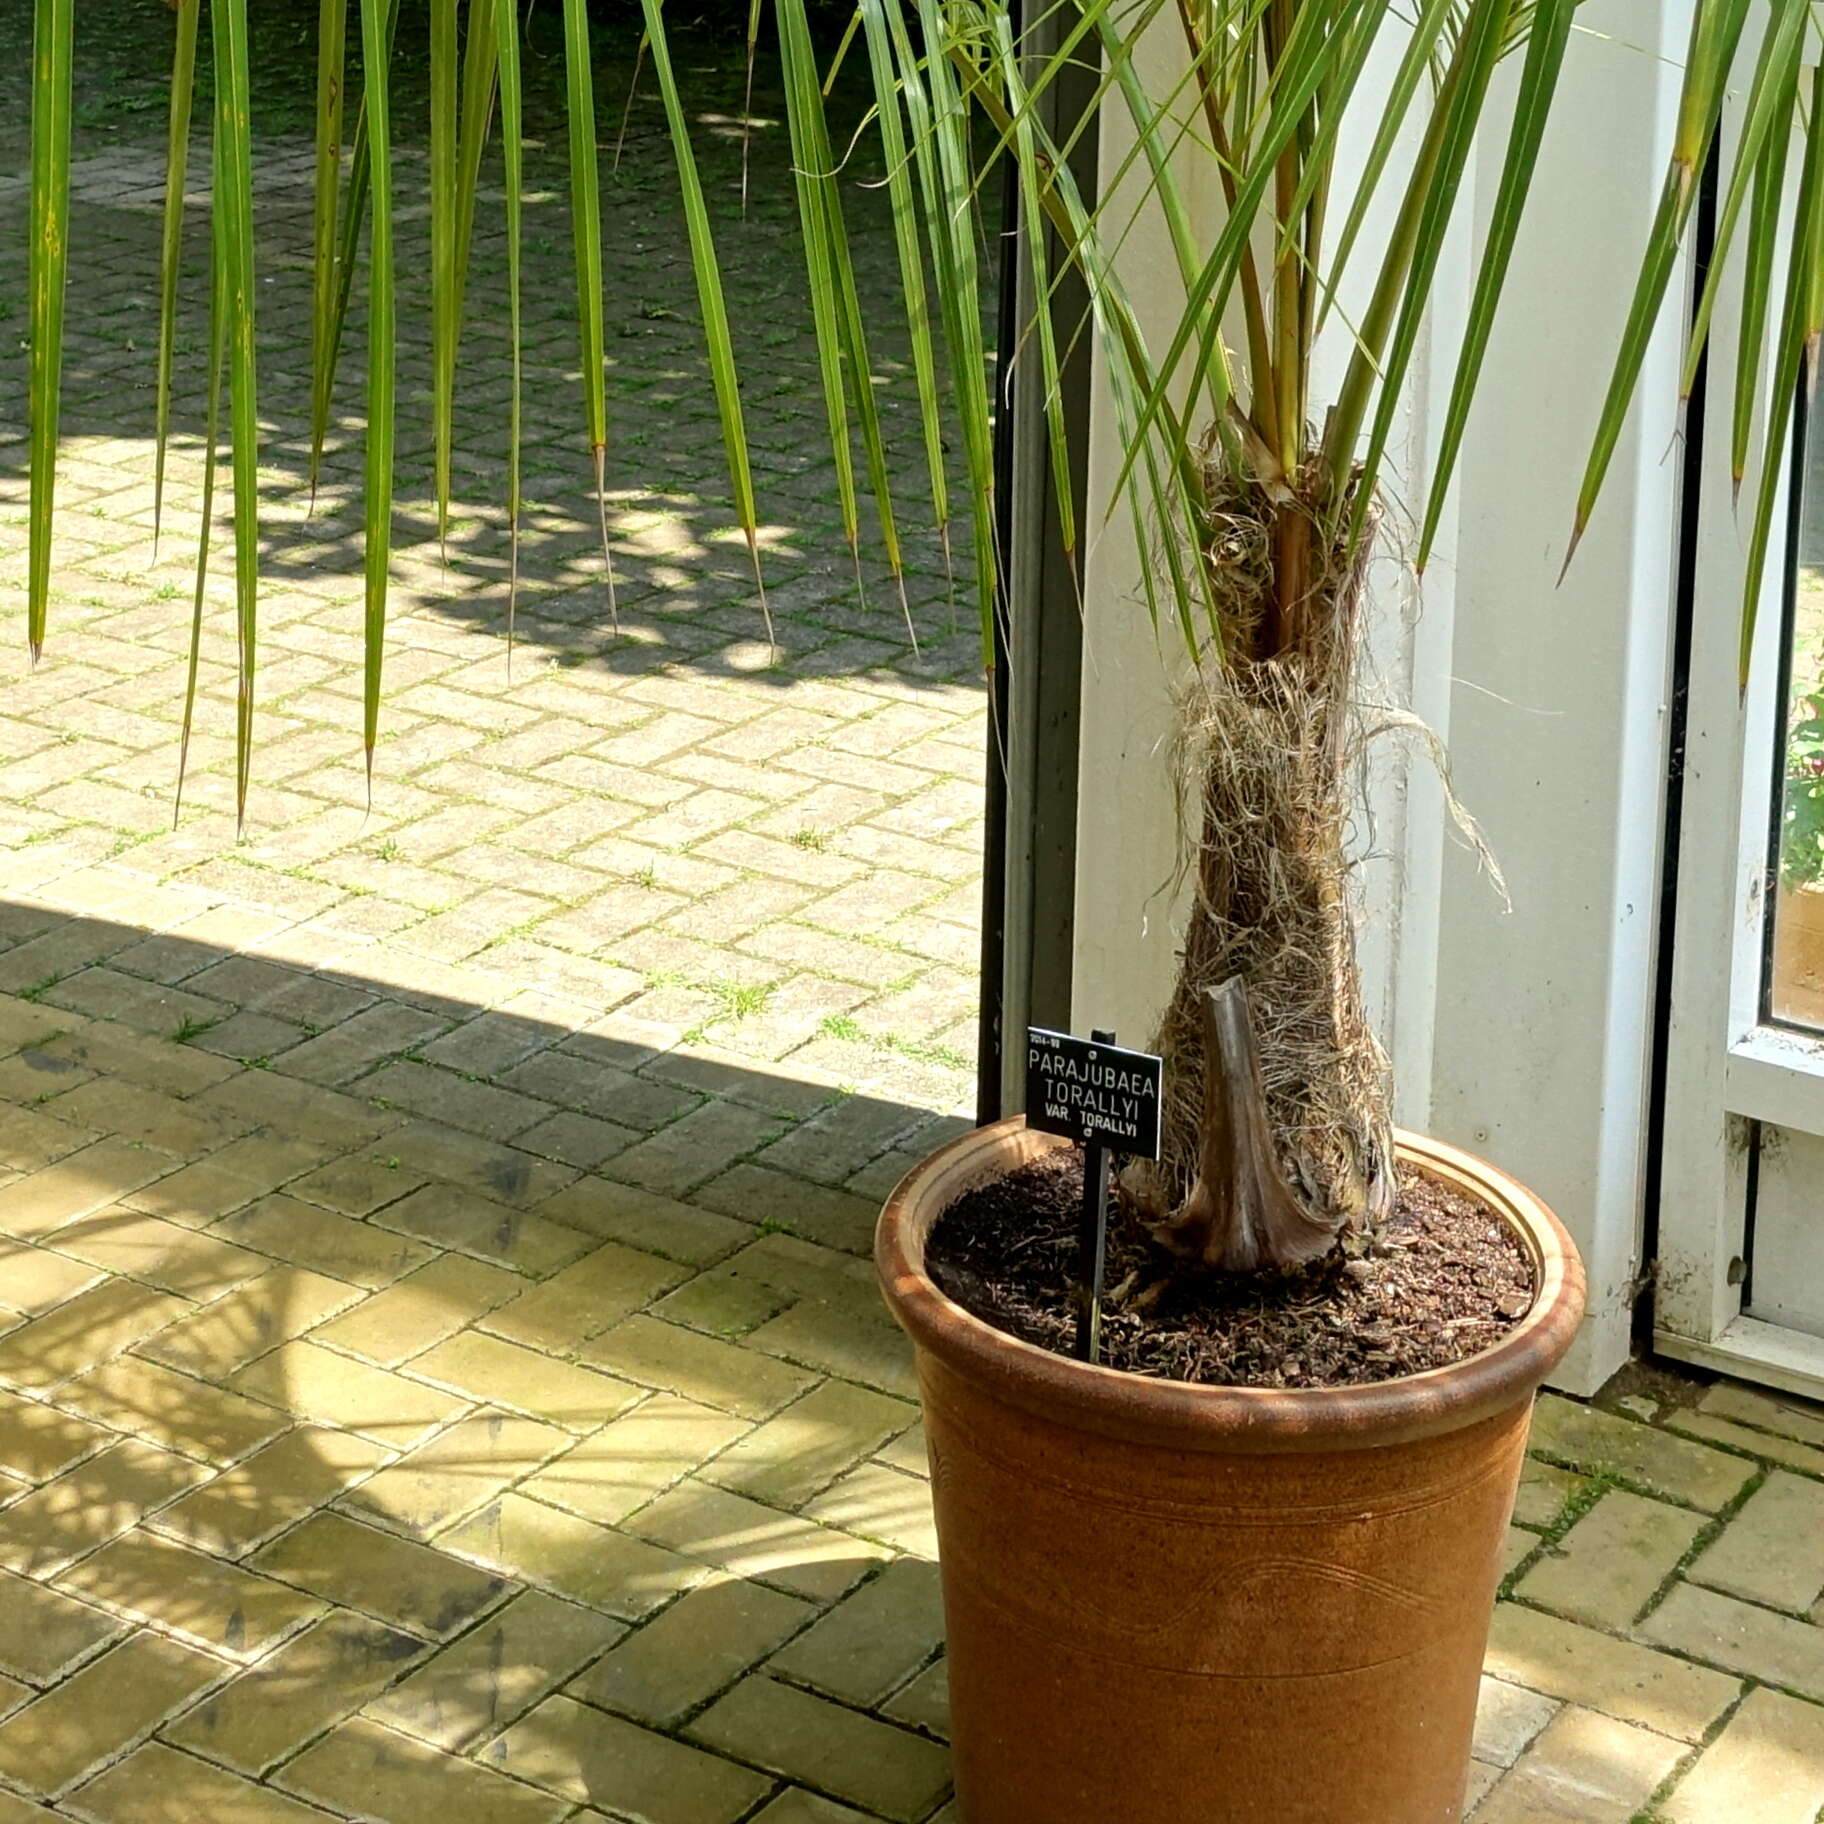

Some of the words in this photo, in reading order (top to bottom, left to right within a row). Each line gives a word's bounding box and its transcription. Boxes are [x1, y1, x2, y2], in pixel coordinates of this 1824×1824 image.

[1029, 1049, 1155, 1098] PARAJUBAEA
[1045, 1078, 1138, 1120] TORALLYI
[1045, 1102, 1072, 1122] VAR.
[1080, 1110, 1137, 1138] TORALLYI
